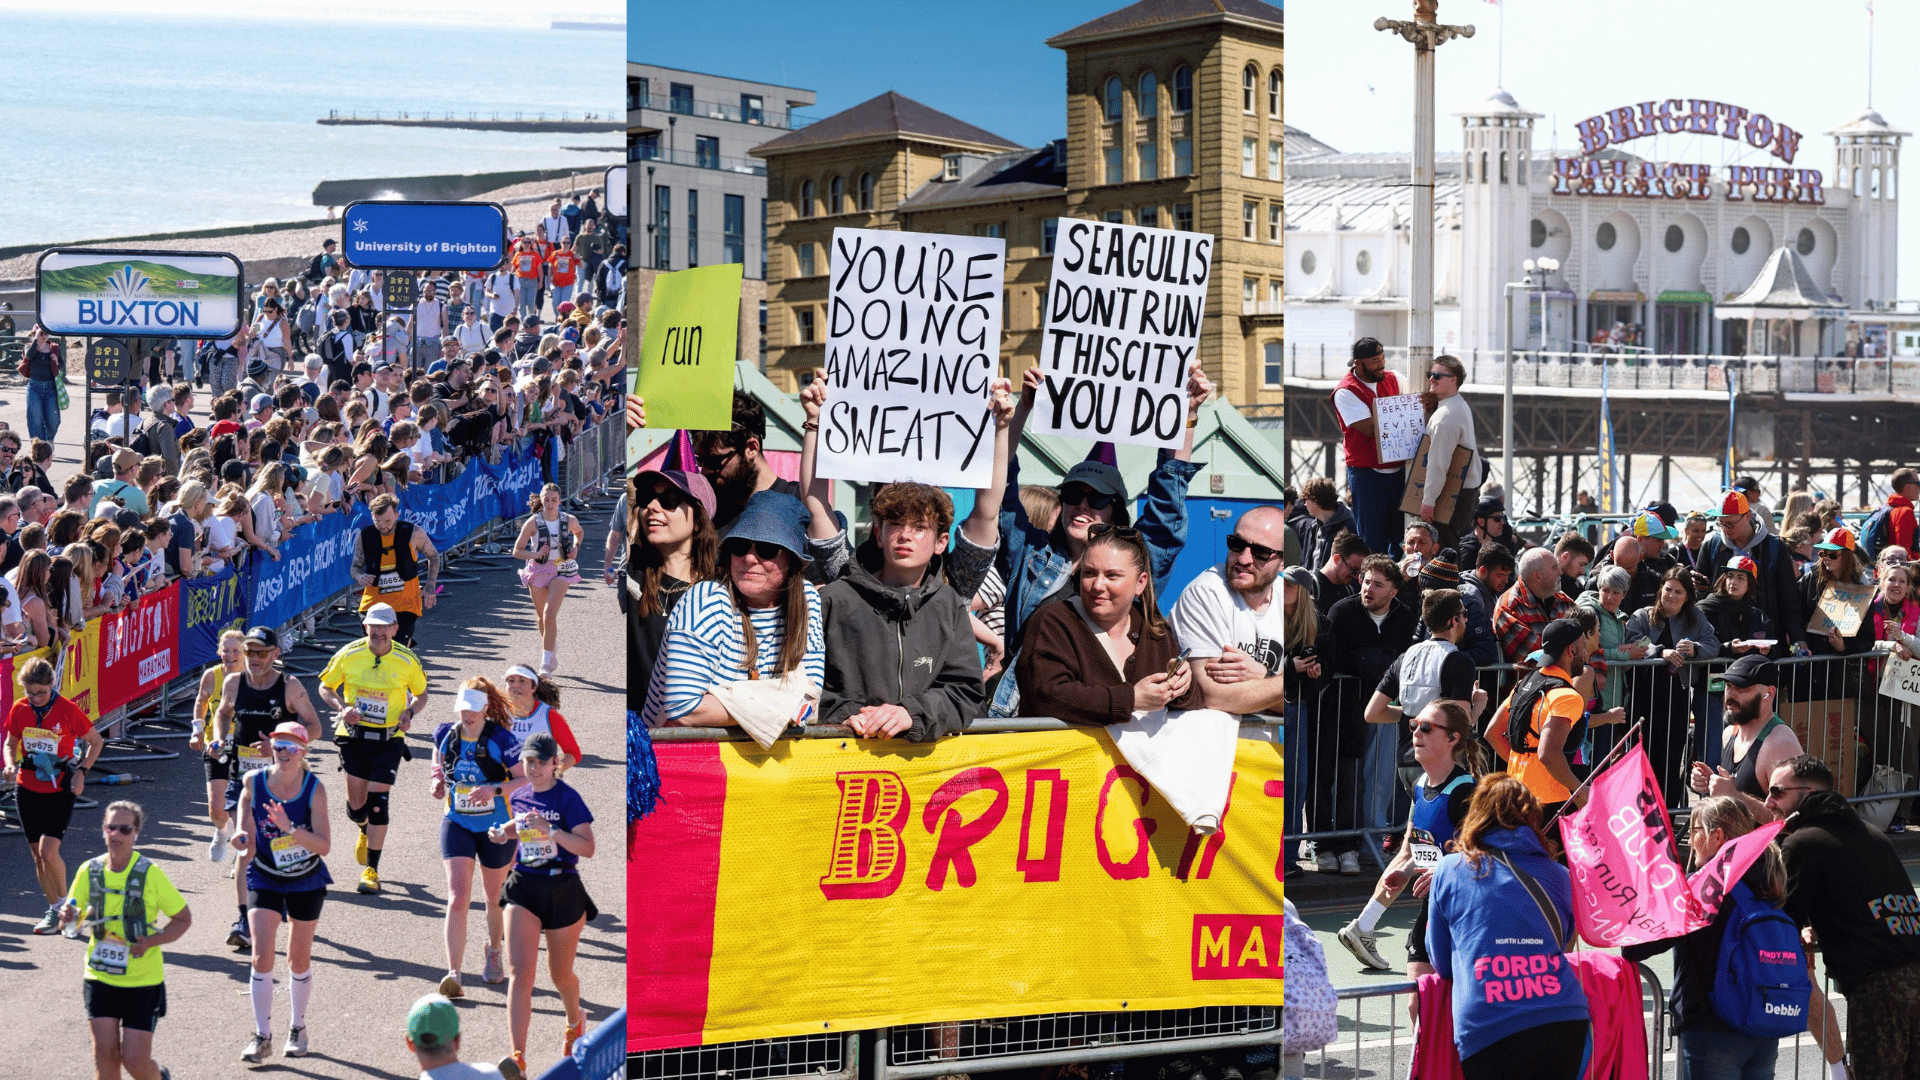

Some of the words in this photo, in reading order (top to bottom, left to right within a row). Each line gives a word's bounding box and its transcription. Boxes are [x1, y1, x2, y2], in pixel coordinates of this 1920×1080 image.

[1575, 98, 1803, 164] BRIGHTON
[1552, 157, 1711, 201] PALACE
[1727, 164, 1825, 205] PIER
[355, 241, 422, 253] University
[425, 242, 438, 252] of
[441, 242, 497, 254] Brighton
[837, 236, 998, 302] YOU'RE
[1063, 223, 1210, 286] SEAGULLS
[78, 299, 199, 326] BUXTON
[830, 296, 990, 353] DOING
[1051, 278, 1138, 331] DON'T
[1139, 289, 1203, 339] RUN
[661, 324, 702, 366] run
[826, 346, 991, 400] AMAZING
[1044, 375, 1121, 435] YOU
[1130, 387, 1182, 441] DO
[1382, 402, 1419, 414] BERTIE
[826, 401, 990, 470] SWEATY
[1824, 603, 1836, 614] TO
[105, 598, 170, 668] BRIGHTON
[1198, 925, 1284, 968] MA
[1885, 915, 1920, 935] RUN
[1475, 954, 1560, 980] FORDY
[1485, 974, 1561, 1003] RUNS
